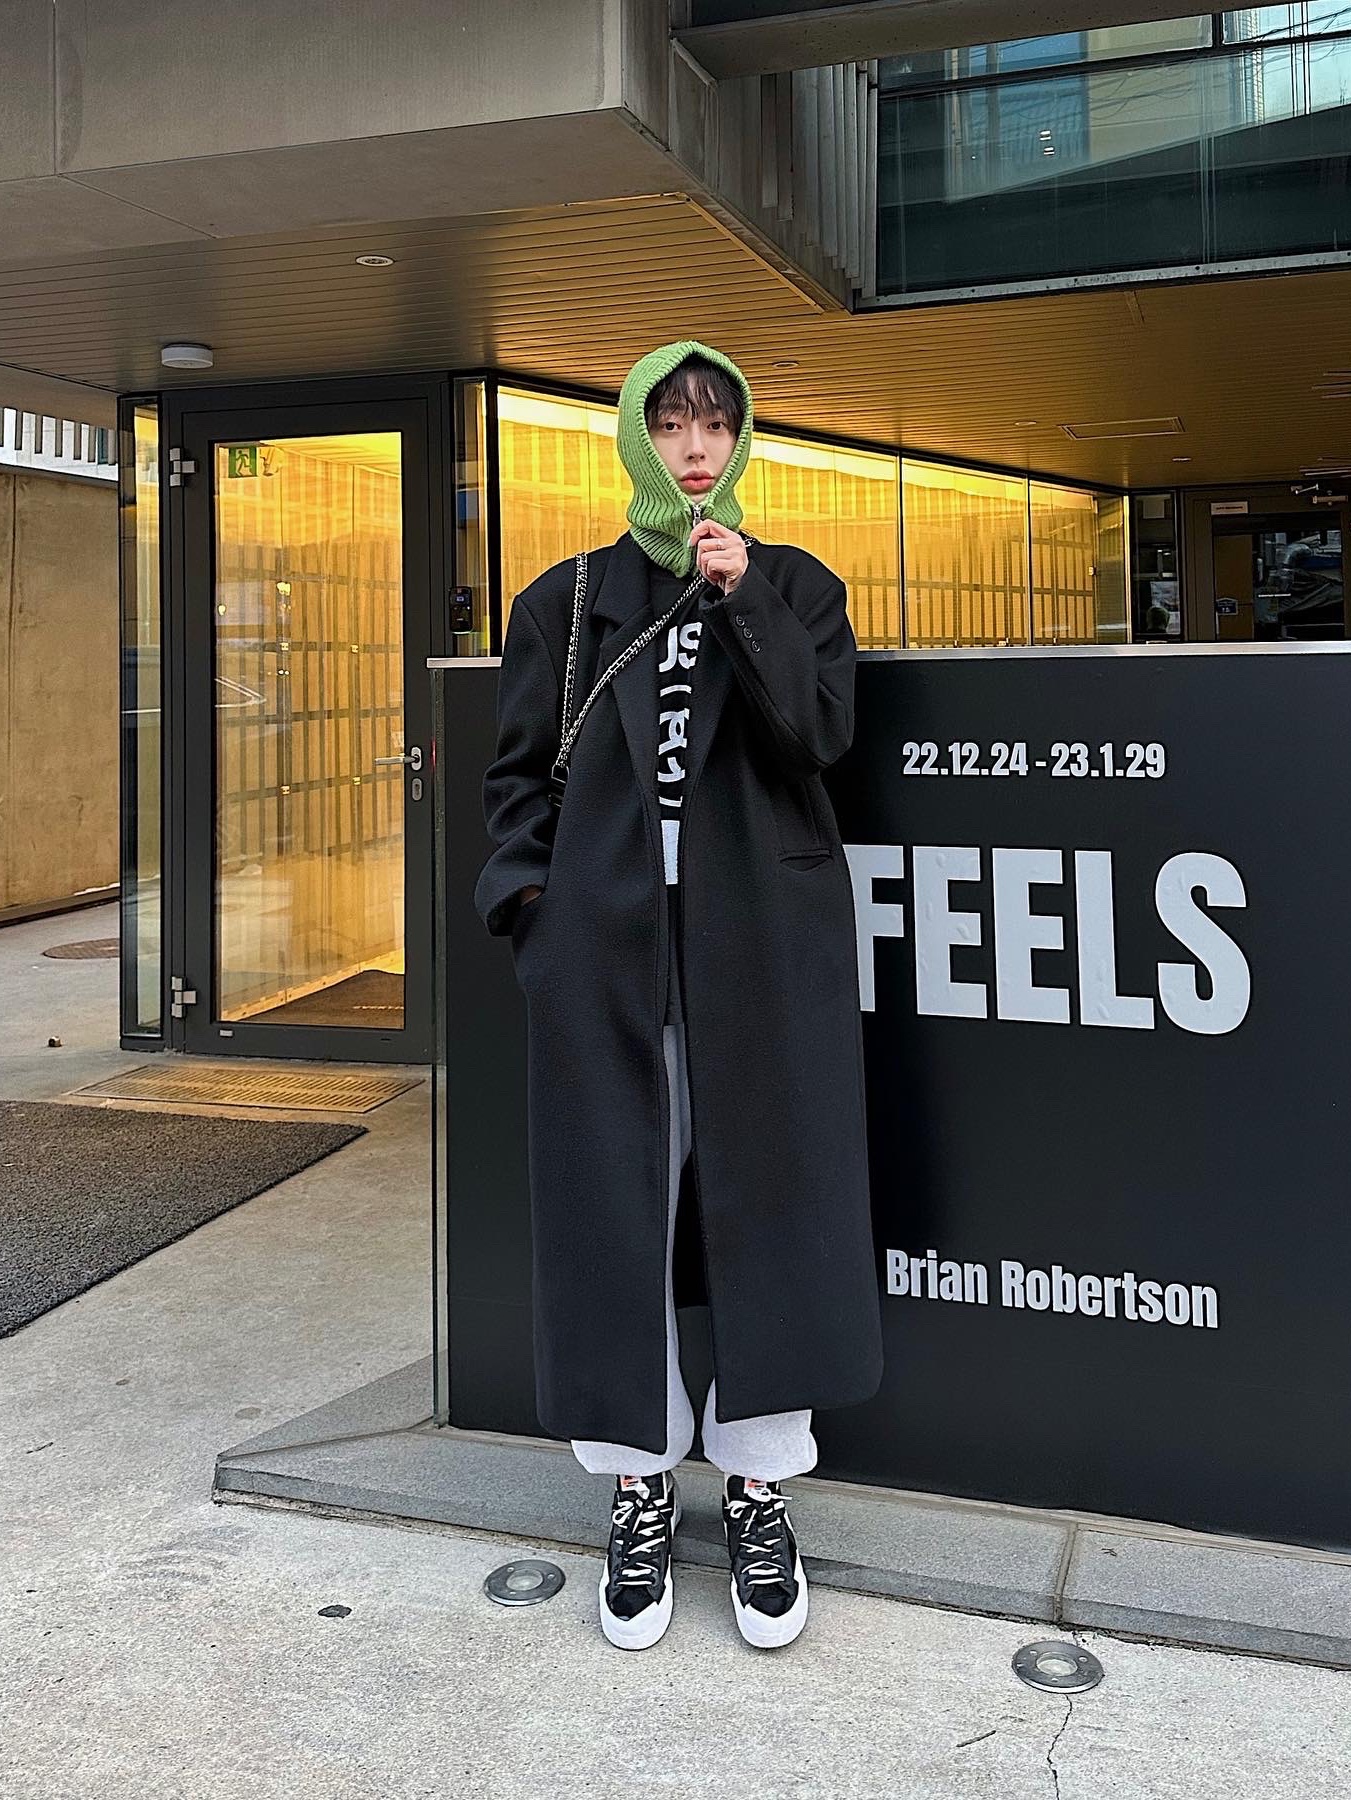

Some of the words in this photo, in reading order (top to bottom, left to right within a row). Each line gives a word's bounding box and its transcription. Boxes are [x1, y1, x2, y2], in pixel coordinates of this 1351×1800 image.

[842, 844, 1251, 1035] FEELS
[886, 1248, 989, 1305] Brian
[1000, 1259, 1218, 1329] Robertson
